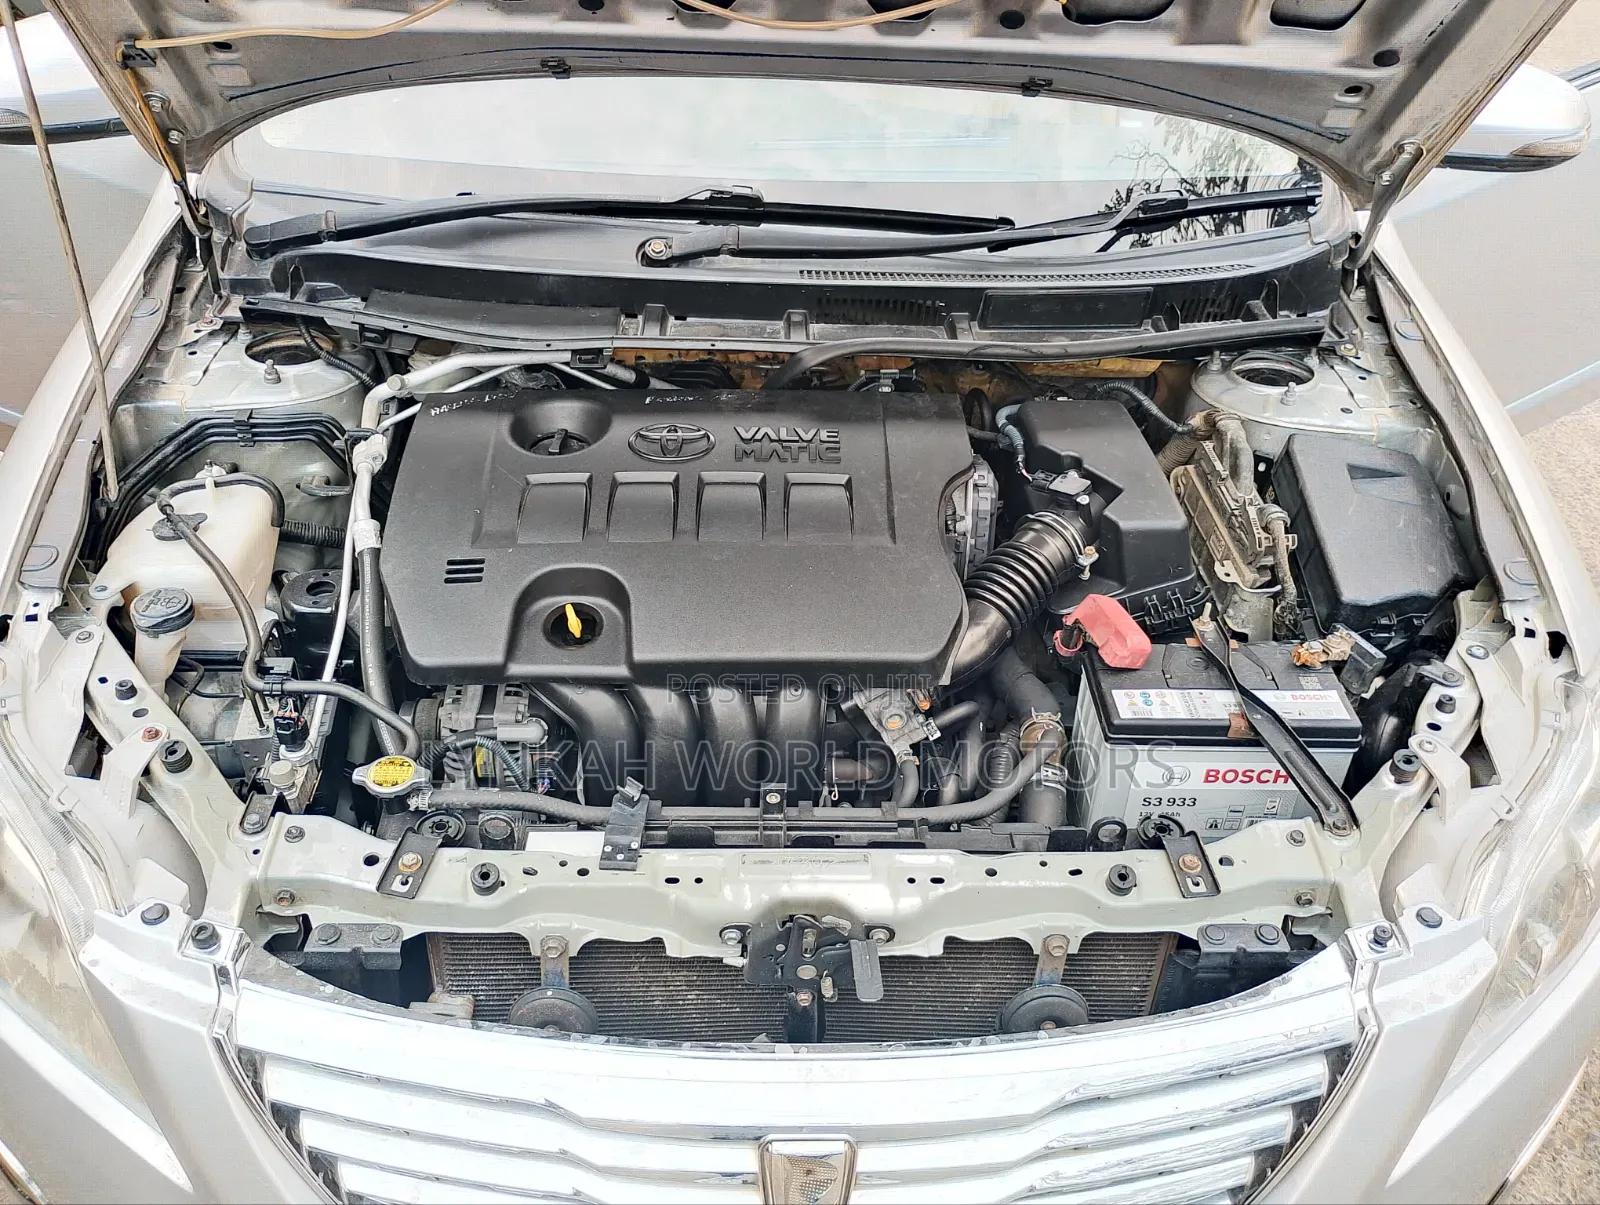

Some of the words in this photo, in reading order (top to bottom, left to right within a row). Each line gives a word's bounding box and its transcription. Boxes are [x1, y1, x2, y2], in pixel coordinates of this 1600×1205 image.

[733, 426, 840, 443] VALVE
[735, 442, 841, 463] MATIC
[1203, 768, 1290, 784] BOSCH
[1141, 797, 1163, 807] S3
[1166, 797, 1198, 807] 933
